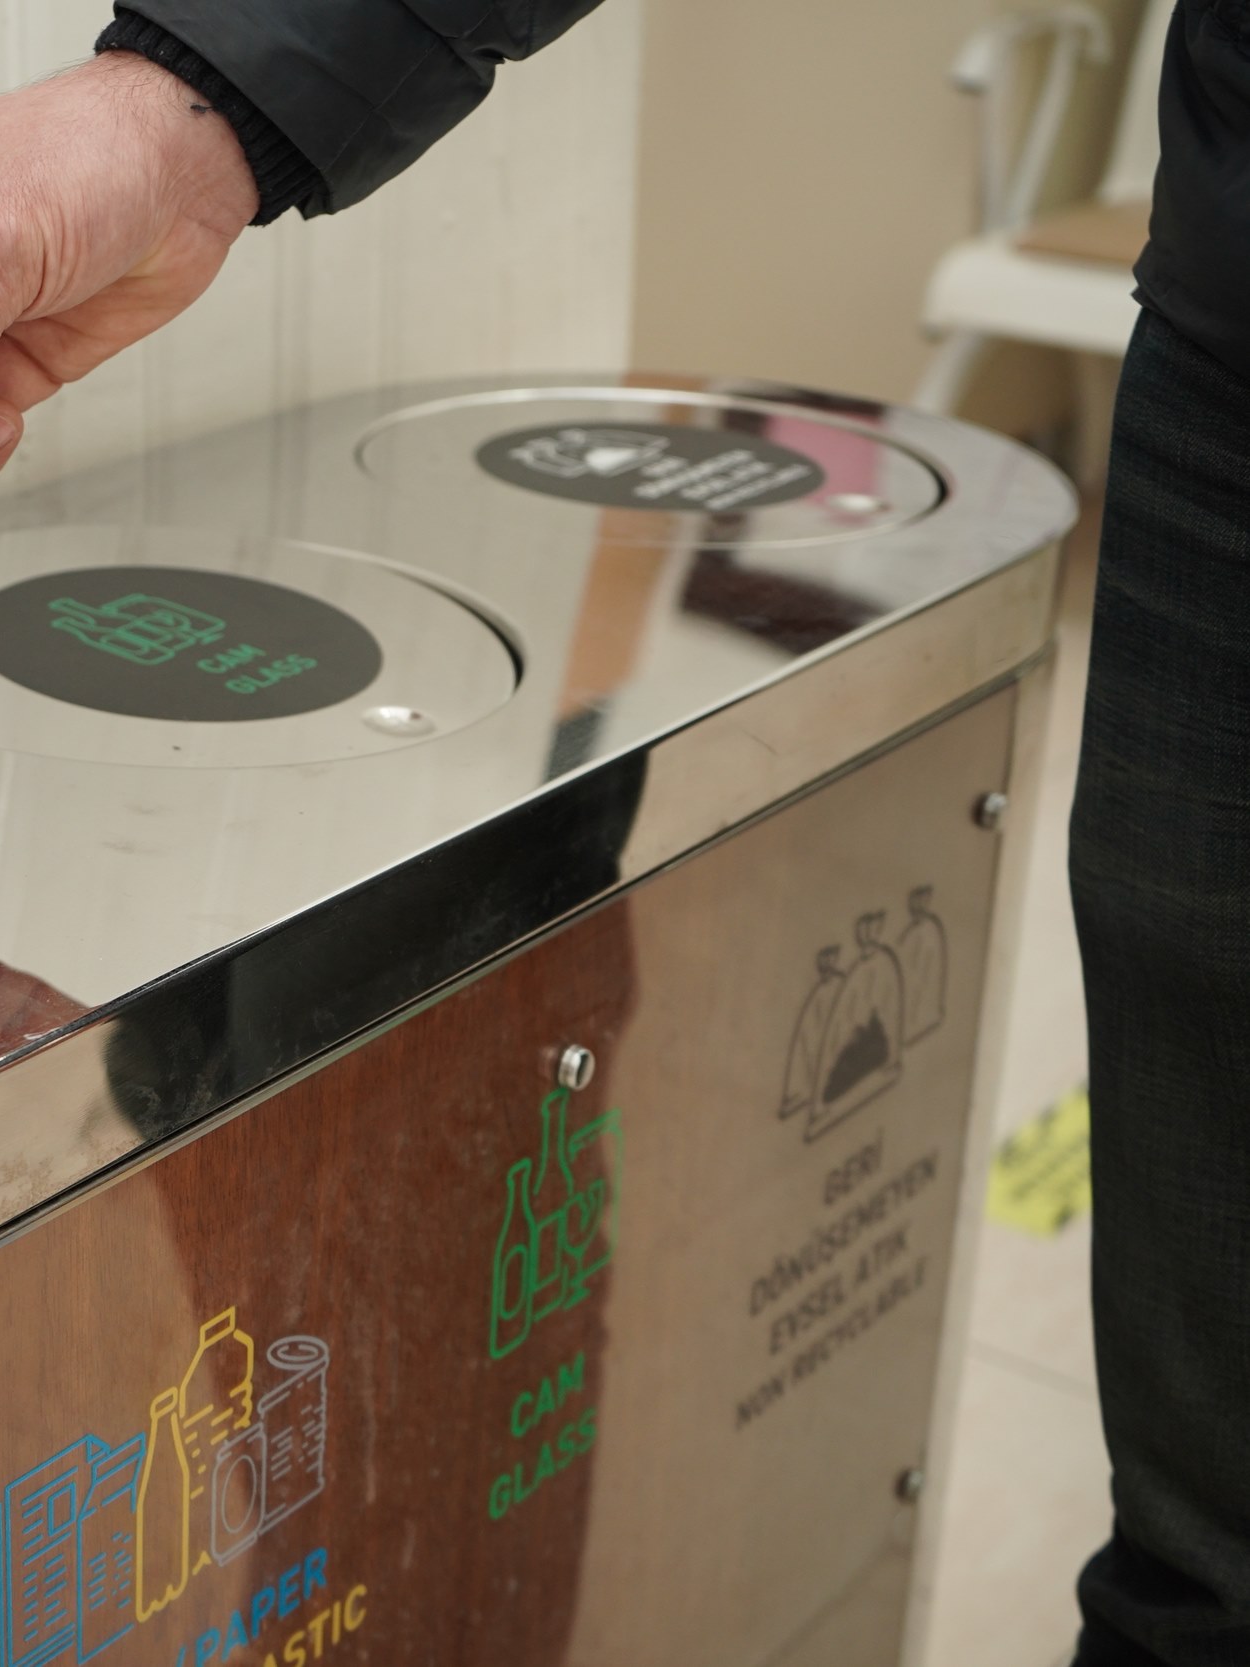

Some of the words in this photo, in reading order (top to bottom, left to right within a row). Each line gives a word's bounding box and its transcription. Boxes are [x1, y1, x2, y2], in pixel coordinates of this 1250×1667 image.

[197, 643, 266, 674] CAM
[225, 653, 318, 694] GLASS
[488, 1407, 598, 1520] GLASS
[194, 1547, 328, 1667] PAPER
